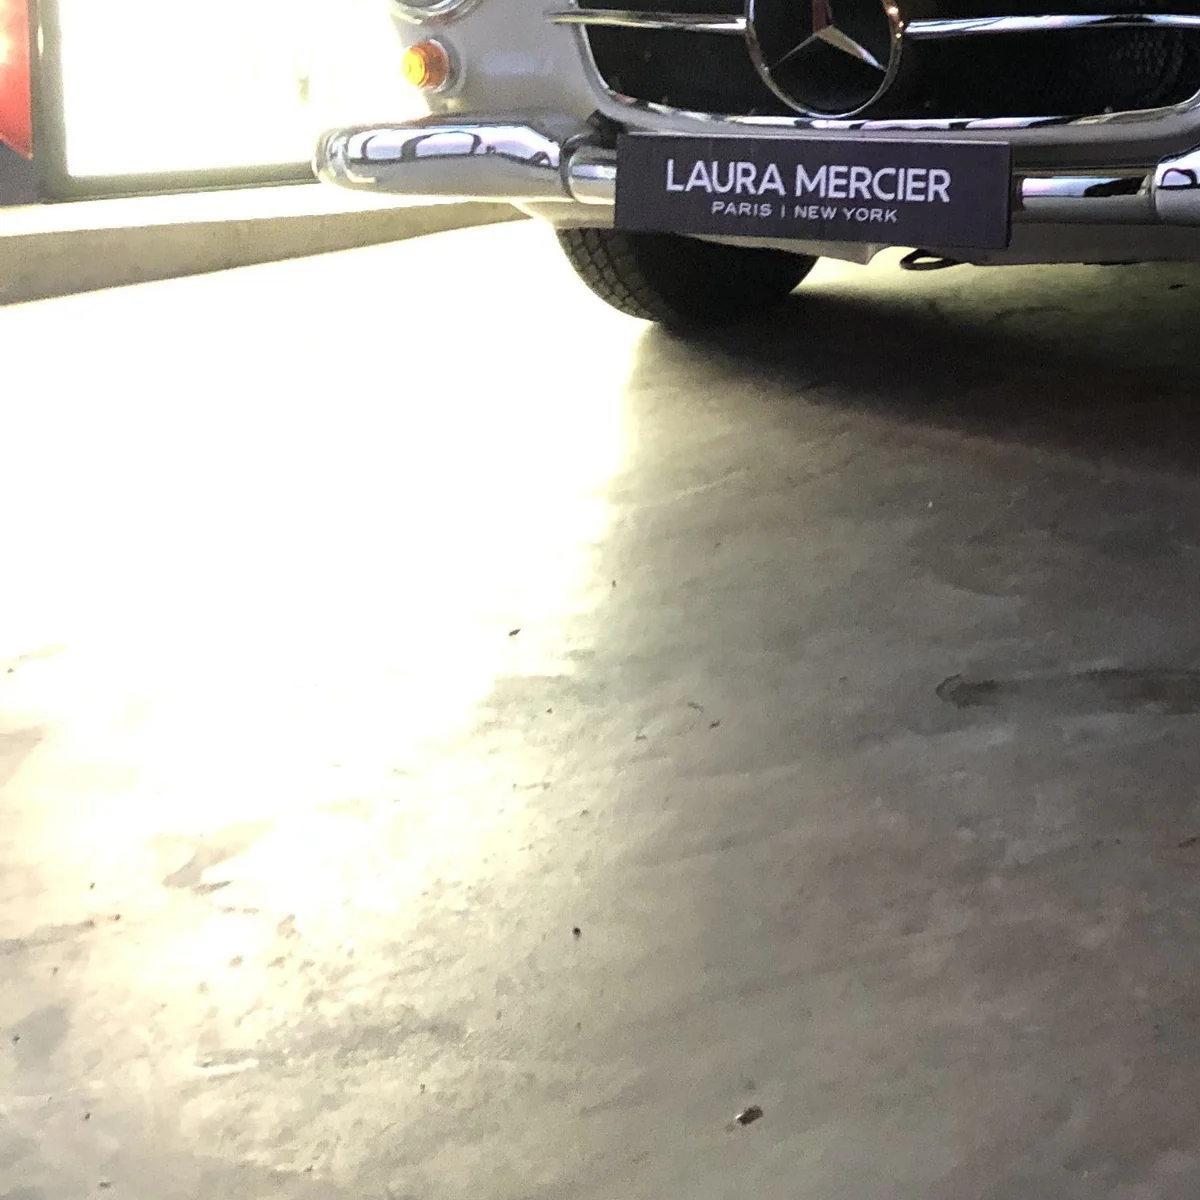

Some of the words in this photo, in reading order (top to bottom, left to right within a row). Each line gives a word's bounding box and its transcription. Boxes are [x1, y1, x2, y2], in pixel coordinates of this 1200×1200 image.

[665, 158, 786, 196] LAURA
[795, 163, 952, 203] MERCIER
[711, 201, 773, 218] PARIS
[794, 205, 838, 221] NEW
[843, 207, 898, 224] YORK
